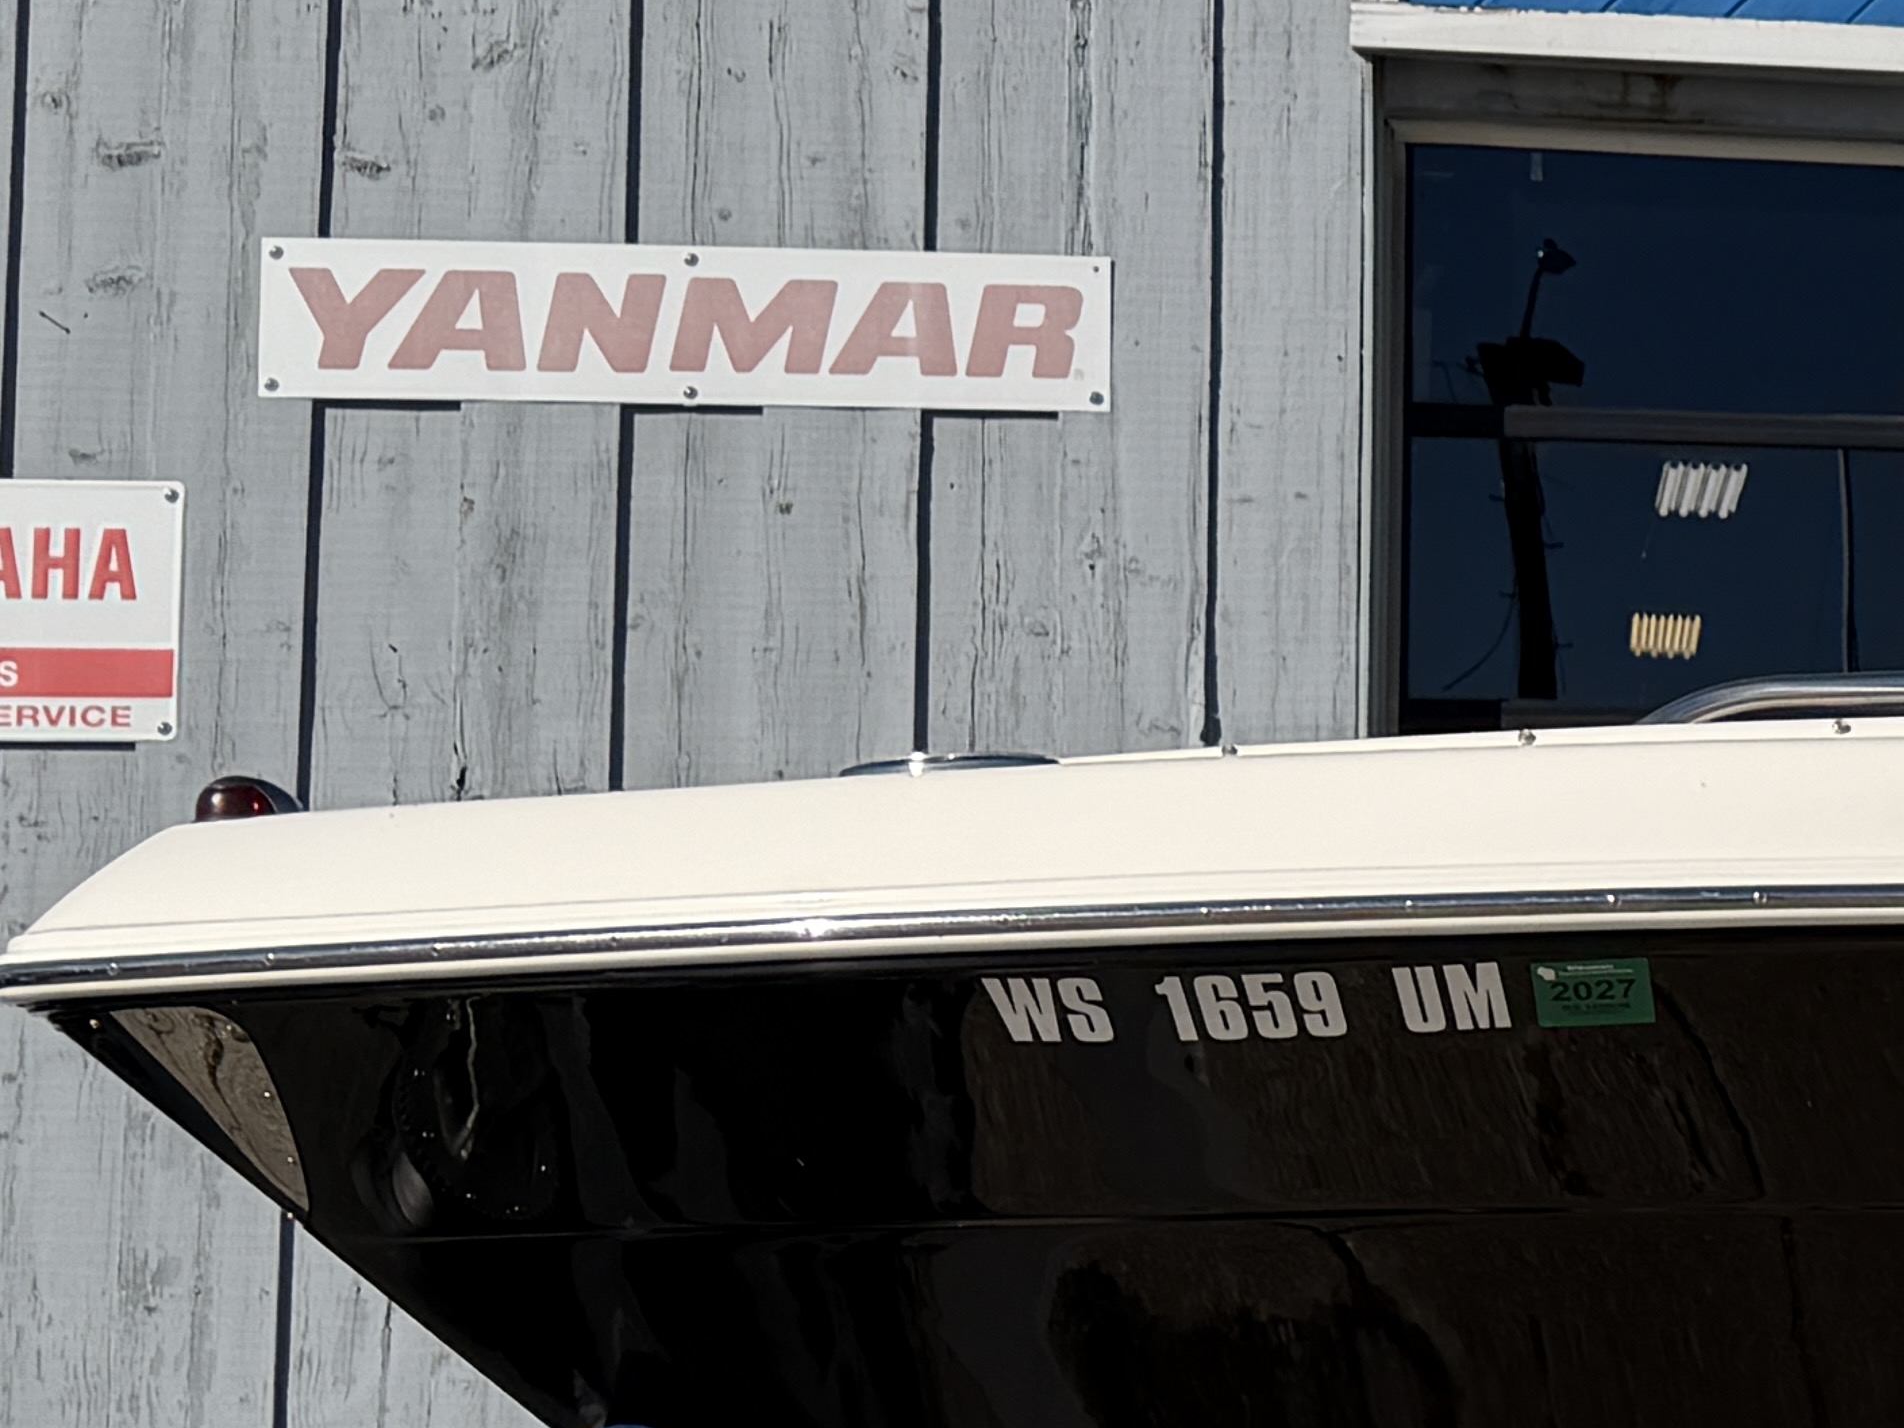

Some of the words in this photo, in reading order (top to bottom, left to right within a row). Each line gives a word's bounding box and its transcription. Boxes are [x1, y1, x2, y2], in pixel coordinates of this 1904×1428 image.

[289, 267, 1085, 378] YANMAR
[981, 977, 1114, 1043] WS
[1156, 972, 1347, 1042] 1659
[1393, 962, 1511, 1033] UM
[1551, 978, 1635, 1002] 2027
